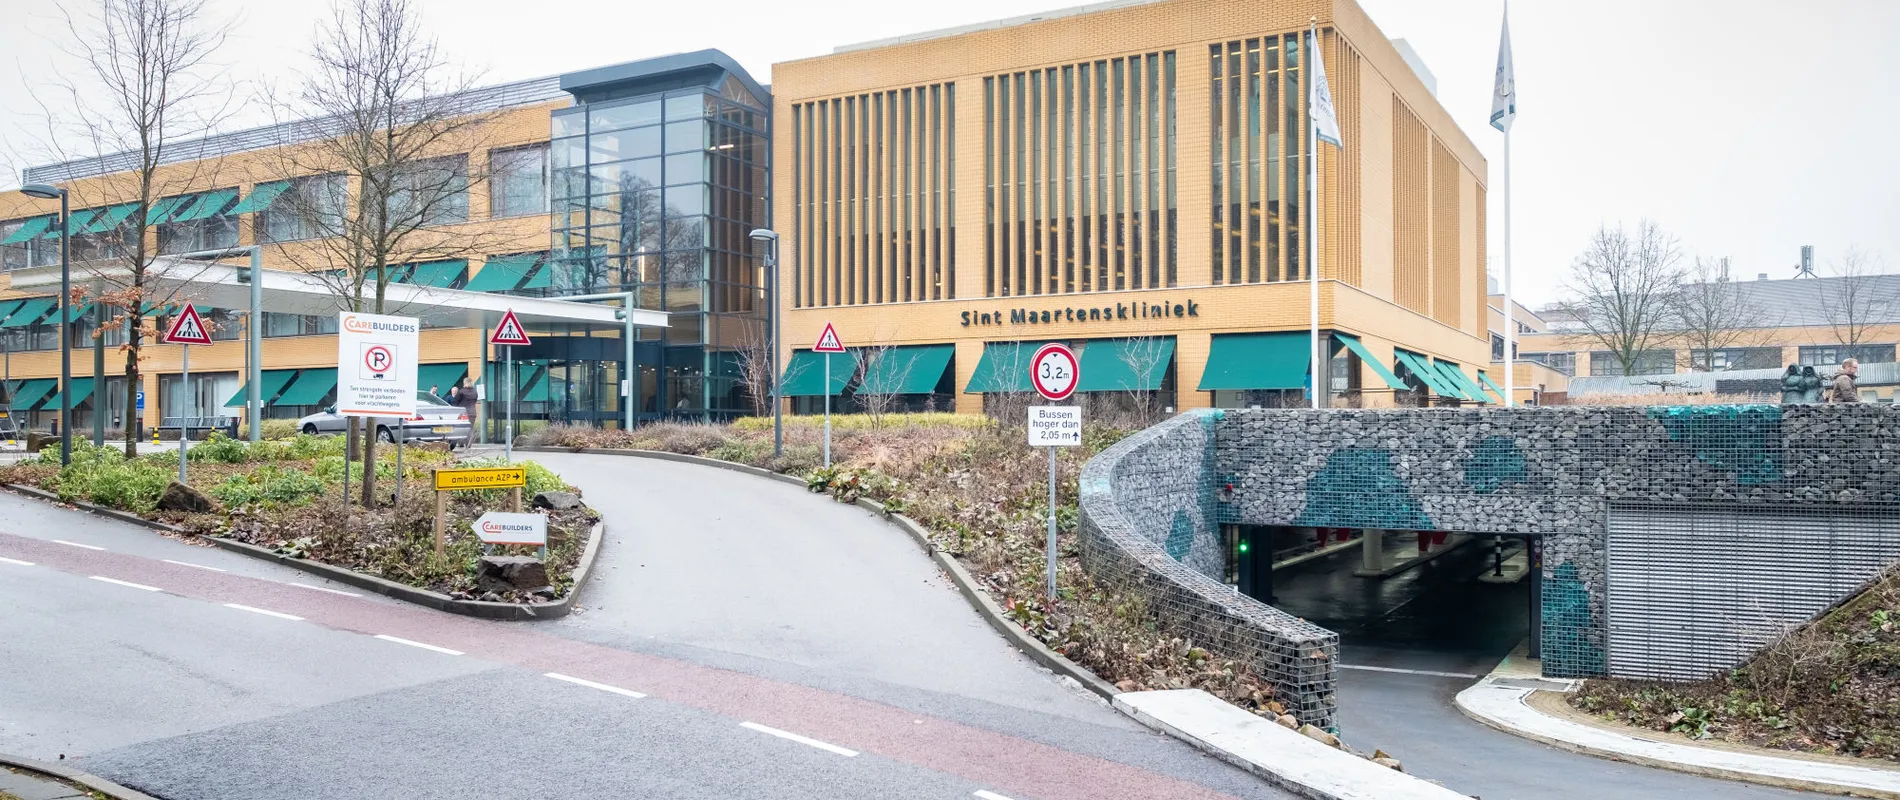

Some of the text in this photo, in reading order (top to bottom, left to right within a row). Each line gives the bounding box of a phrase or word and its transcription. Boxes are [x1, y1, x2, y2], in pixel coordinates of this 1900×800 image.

[960, 299, 1200, 327] Sint Maartenskliniek
[345, 317, 415, 333] CAREBUILDERS
[367, 400, 400, 408] vrachtwagens
[1039, 410, 1073, 419] Bussen
[1032, 419, 1079, 429] hoger dan
[1040, 430, 1060, 441] 2,05
[451, 473, 512, 484] ambulance AZP
[483, 522, 533, 533] CAREBUILDERS
